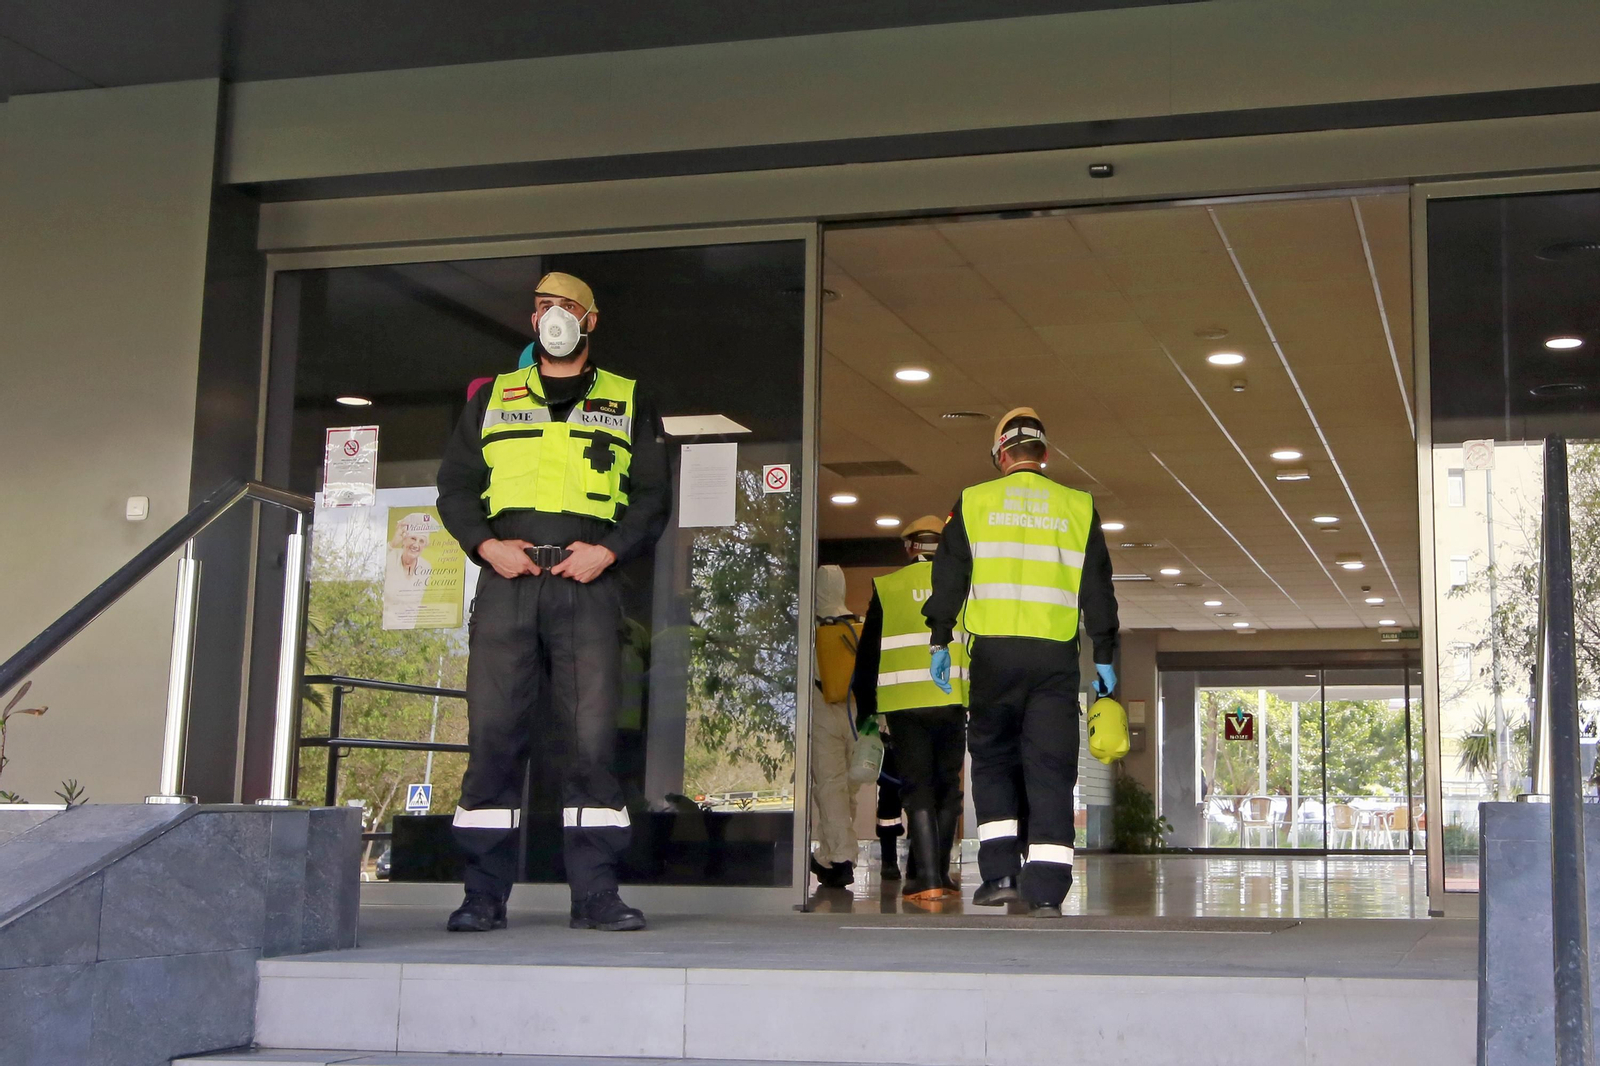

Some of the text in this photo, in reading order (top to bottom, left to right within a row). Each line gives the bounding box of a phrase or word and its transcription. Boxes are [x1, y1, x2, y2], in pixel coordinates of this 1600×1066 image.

[500, 411, 534, 422] UME
[582, 414, 623, 427] RAIEM
[1005, 486, 1050, 500] UNIDAD
[1003, 498, 1050, 514] MILITAR
[988, 511, 1069, 533] EMERGENCIAS
[414, 565, 458, 576] Concurso
[424, 576, 457, 587] Cocina
